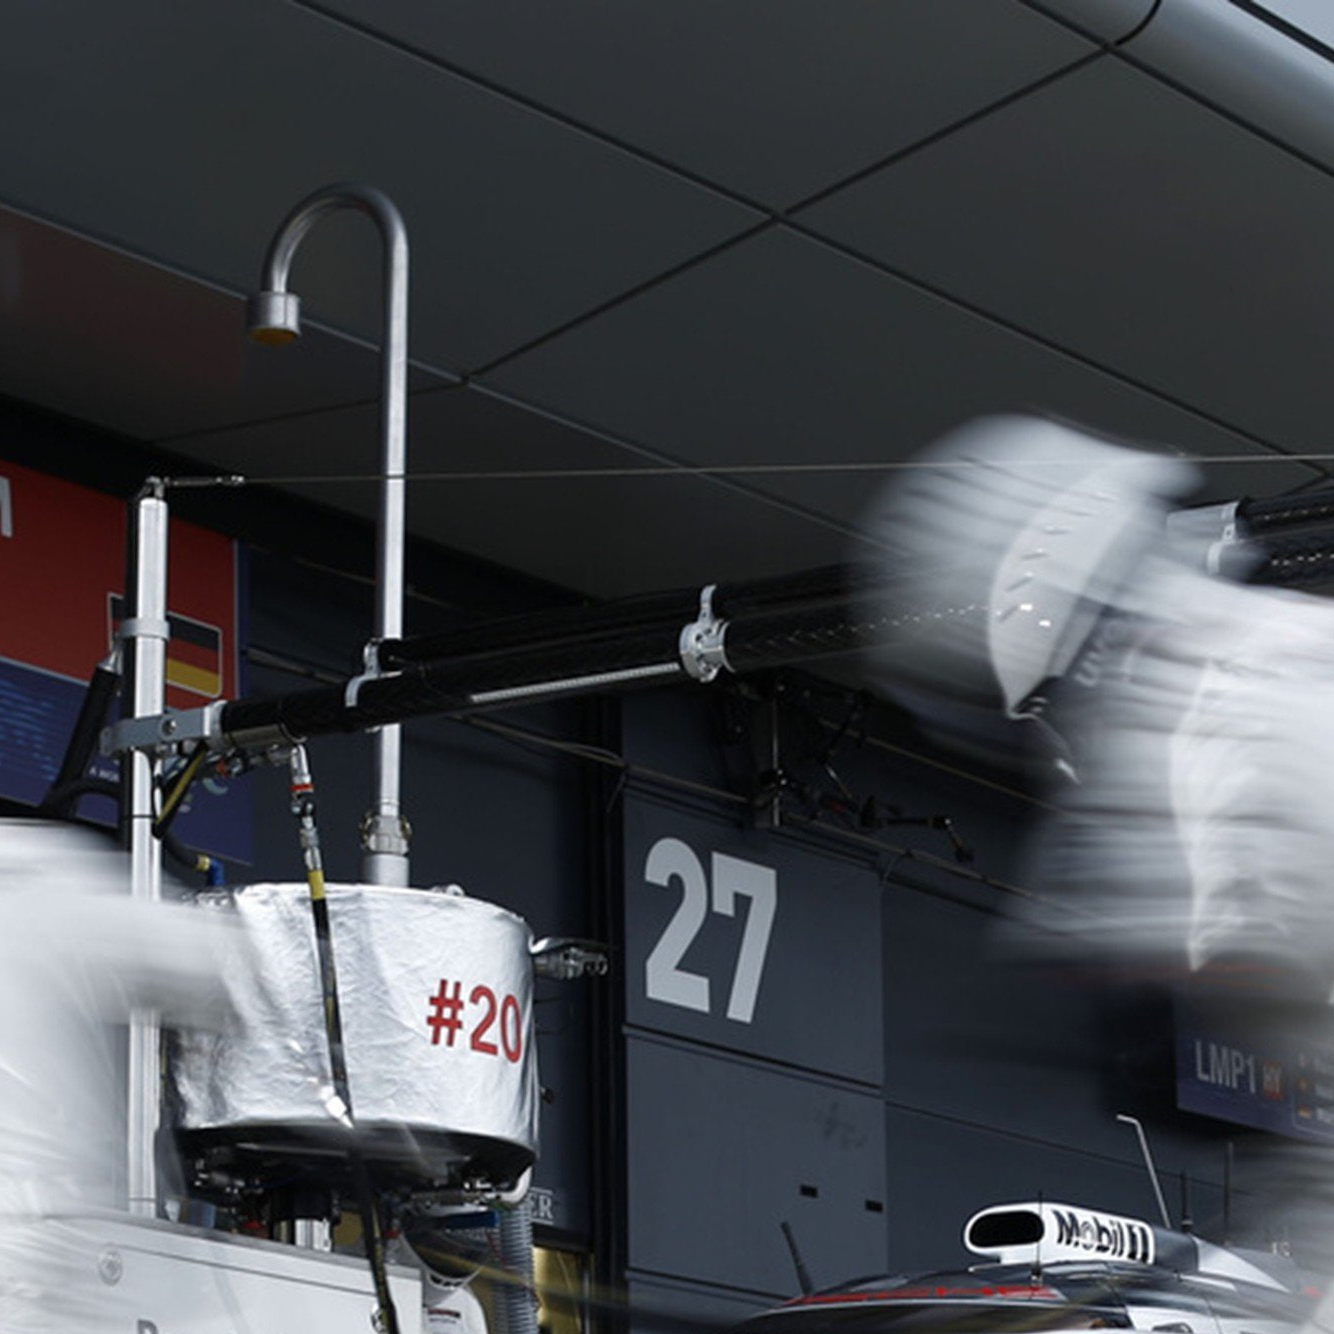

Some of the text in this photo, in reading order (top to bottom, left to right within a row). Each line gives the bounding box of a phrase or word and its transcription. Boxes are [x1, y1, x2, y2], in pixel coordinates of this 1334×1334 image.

[644, 837, 778, 1025] 27
[427, 978, 523, 1064] #20
[1195, 1041, 1255, 1094] LMP1
[1052, 1209, 1125, 1257] Mobil
